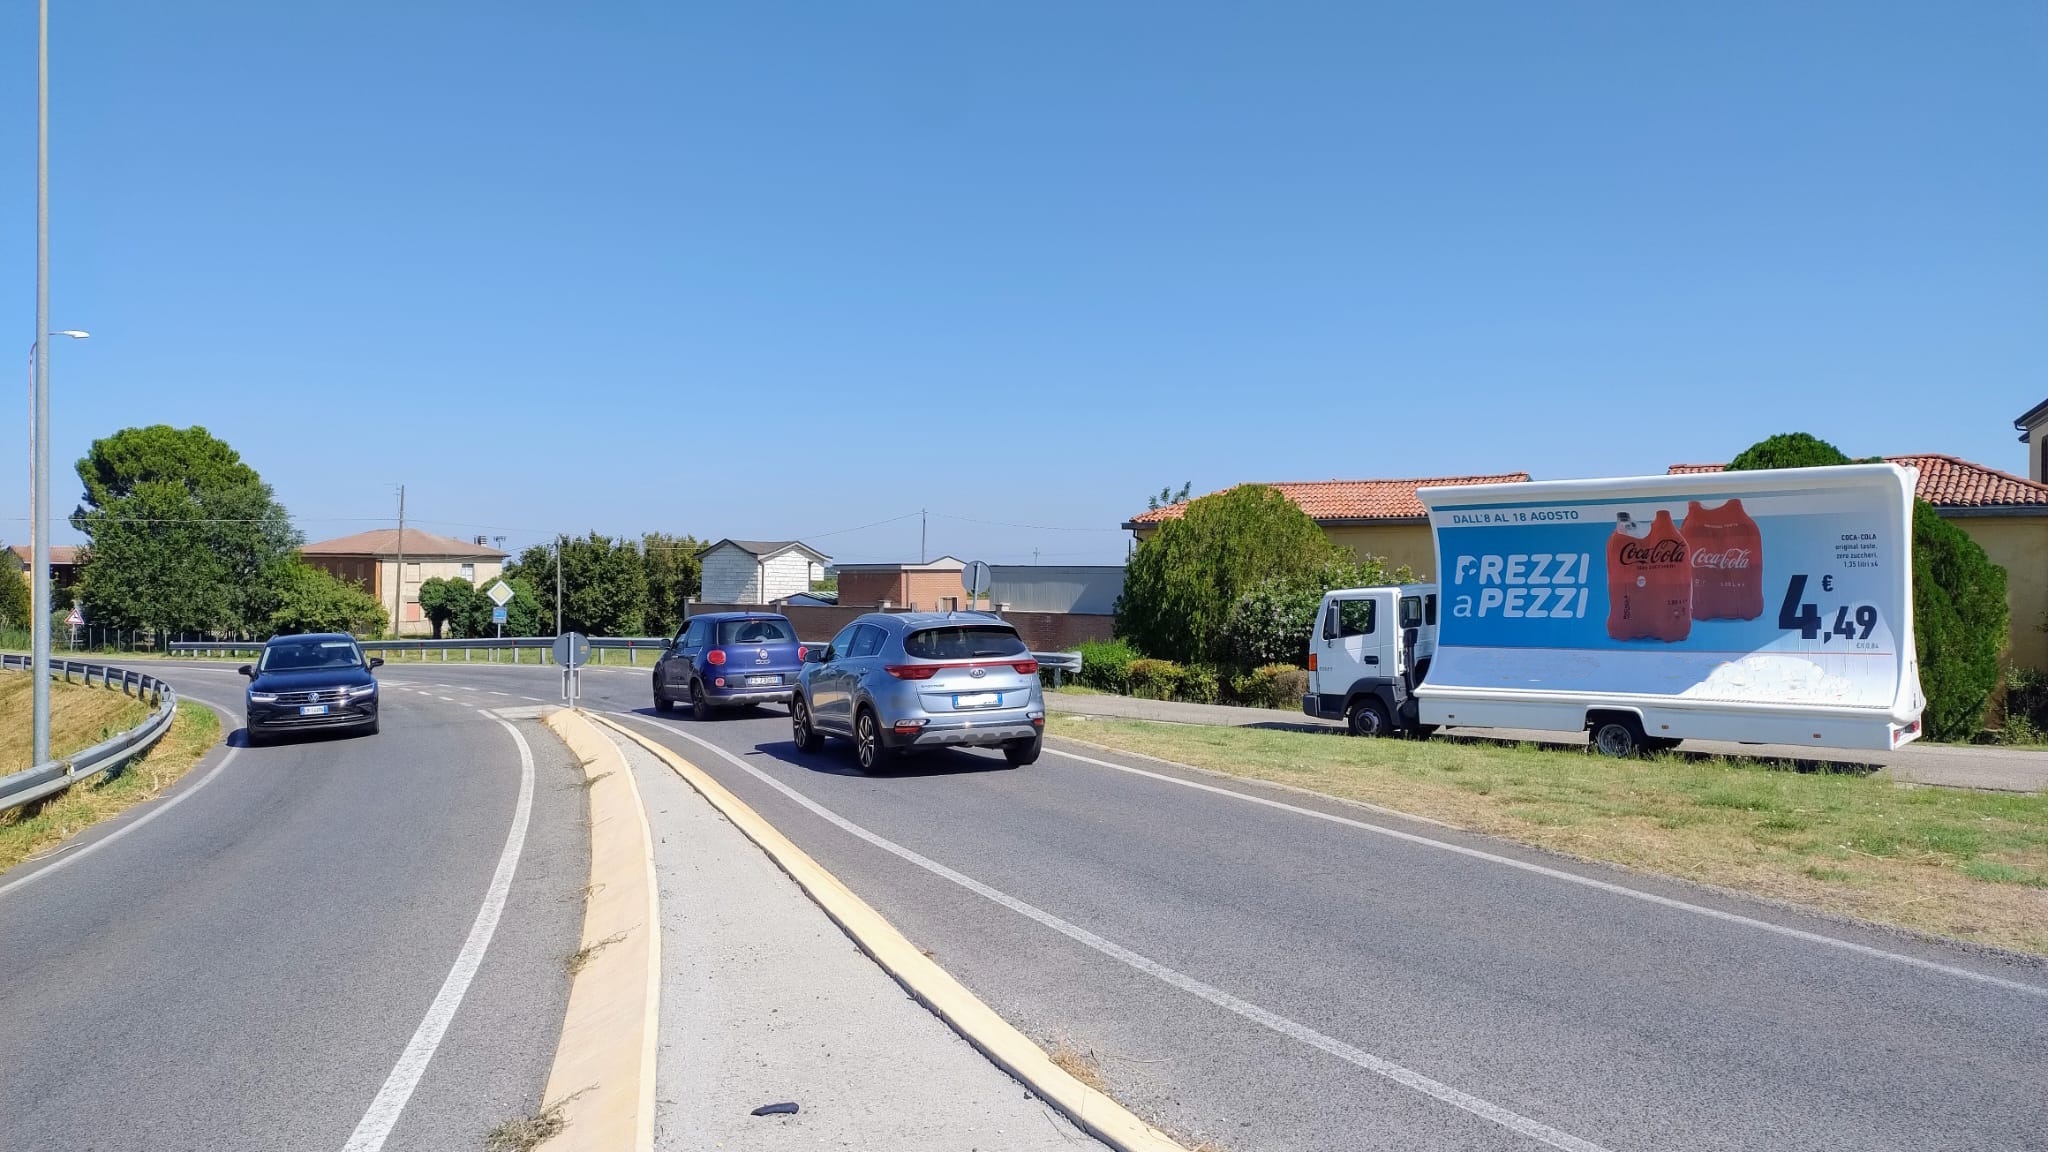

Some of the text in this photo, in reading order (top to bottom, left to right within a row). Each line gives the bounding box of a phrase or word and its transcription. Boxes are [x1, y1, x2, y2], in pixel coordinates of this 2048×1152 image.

[1453, 510, 1579, 524] DALL'8 AL 18 AGOSTO
[1841, 533, 1877, 541] COCA-COLA
[1835, 543, 1859, 551] original
[1454, 552, 1590, 585] PREZZI
[1821, 574, 1834, 592] €
[1453, 587, 1589, 618] a PEZZI
